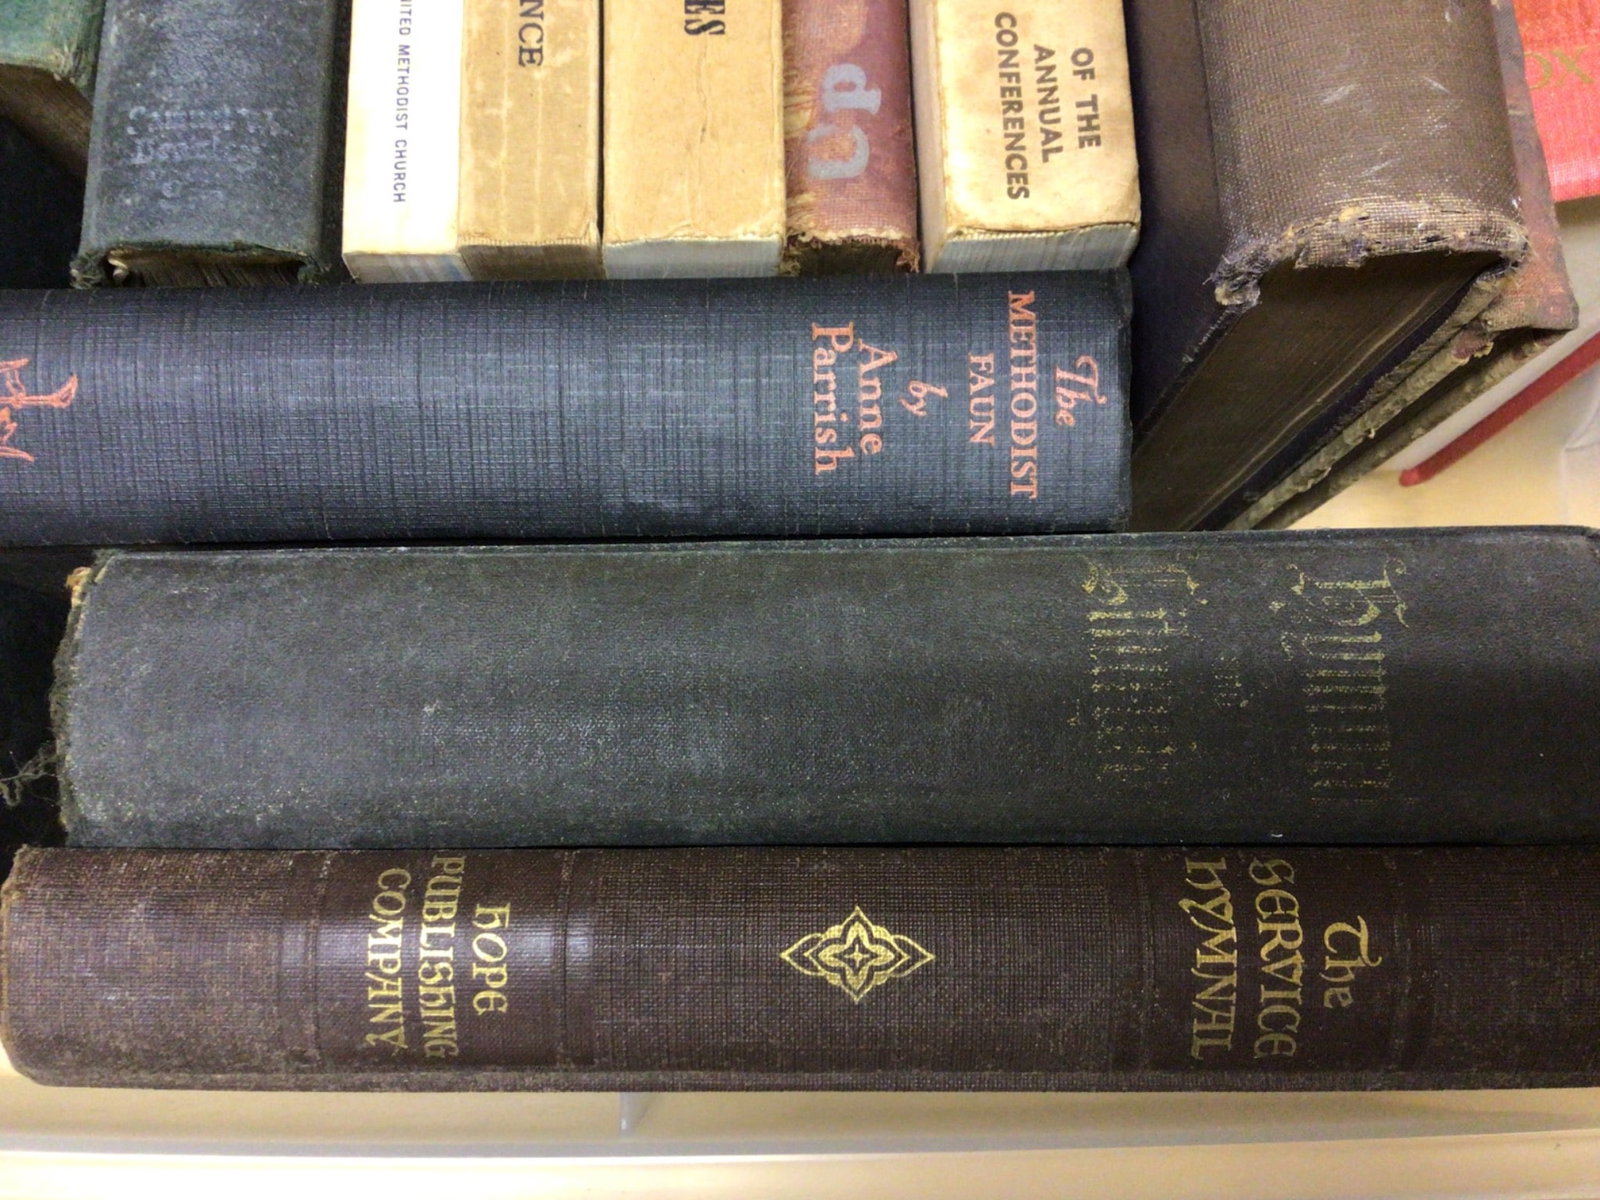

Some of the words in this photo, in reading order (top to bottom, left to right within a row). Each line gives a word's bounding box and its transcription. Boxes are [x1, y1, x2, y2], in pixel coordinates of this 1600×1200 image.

[398, 0, 412, 36] ITED
[1070, 47, 1096, 81] OF
[395, 44, 411, 131] METHODIST
[994, 12, 1031, 200] CONFERENCES
[1033, 44, 1063, 163] ANNUAL
[1075, 94, 1102, 149] THE
[393, 139, 408, 203] CHURCH
[812, 321, 855, 475] Parrish
[858, 338, 898, 455] Anne
[899, 380, 949, 417] by
[968, 353, 996, 446] FAUN
[1008, 290, 1038, 499] METHODIST
[1055, 355, 1108, 427] The
[364, 867, 412, 1051] COMPANY
[418, 855, 467, 1058] PUBLISHING
[1249, 857, 1304, 1059] SERVICE
[1319, 915, 1382, 1008] The
